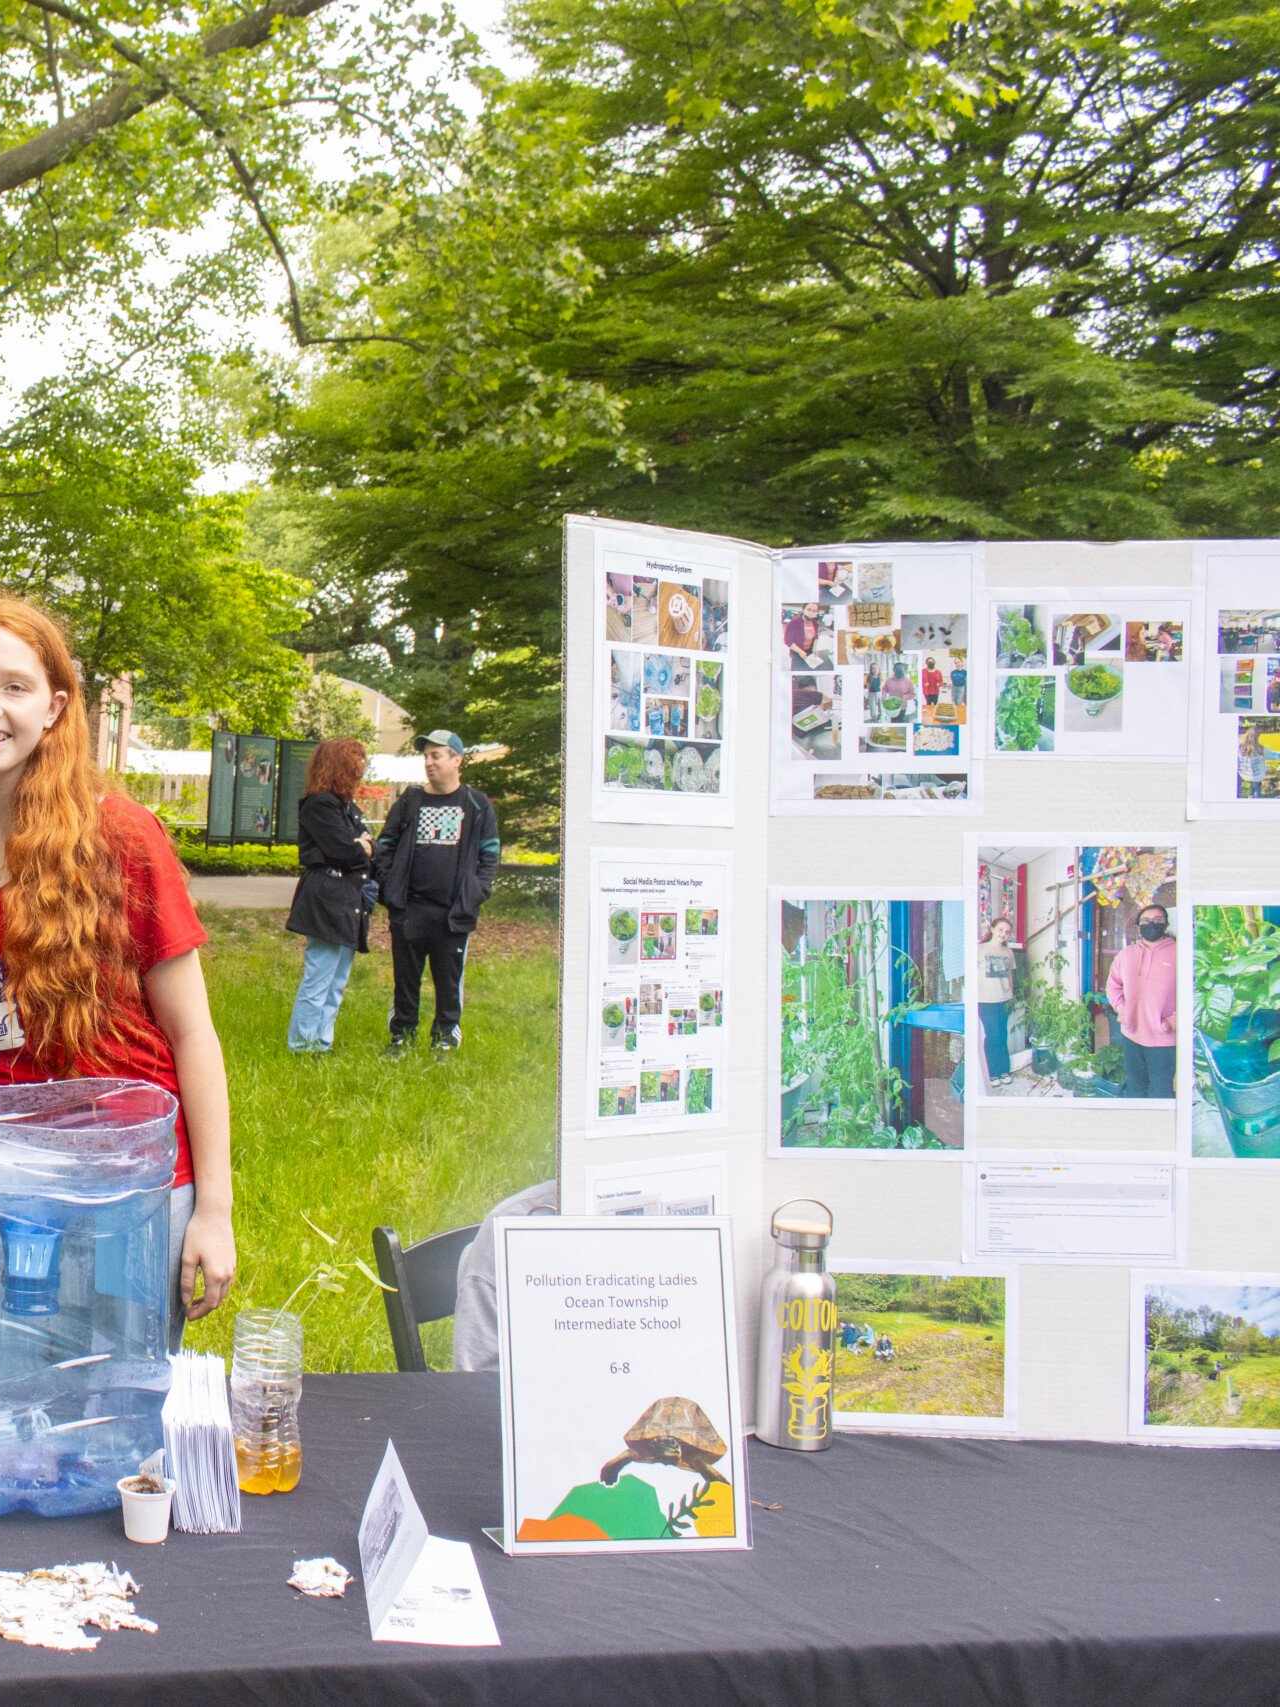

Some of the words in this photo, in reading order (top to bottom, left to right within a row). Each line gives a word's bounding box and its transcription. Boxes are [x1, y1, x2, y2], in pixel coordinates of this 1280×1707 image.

[646, 560, 674, 572] Hydroponic
[674, 564, 692, 574] System
[623, 877, 637, 886] Social
[638, 878, 652, 886] Media
[653, 878, 666, 886] Posts
[667, 878, 675, 886] and
[690, 879, 703, 888] Paper
[525, 1274, 581, 1286] Pollution
[585, 1273, 655, 1289] Eradicating
[659, 1273, 698, 1286] Ladies
[564, 1296, 605, 1308] Ocean
[608, 1295, 669, 1310] Township
[777, 1298, 837, 1332] COLTON
[554, 1317, 636, 1330] Intermediate
[639, 1317, 681, 1330] School
[609, 1361, 631, 1374] 6-8
